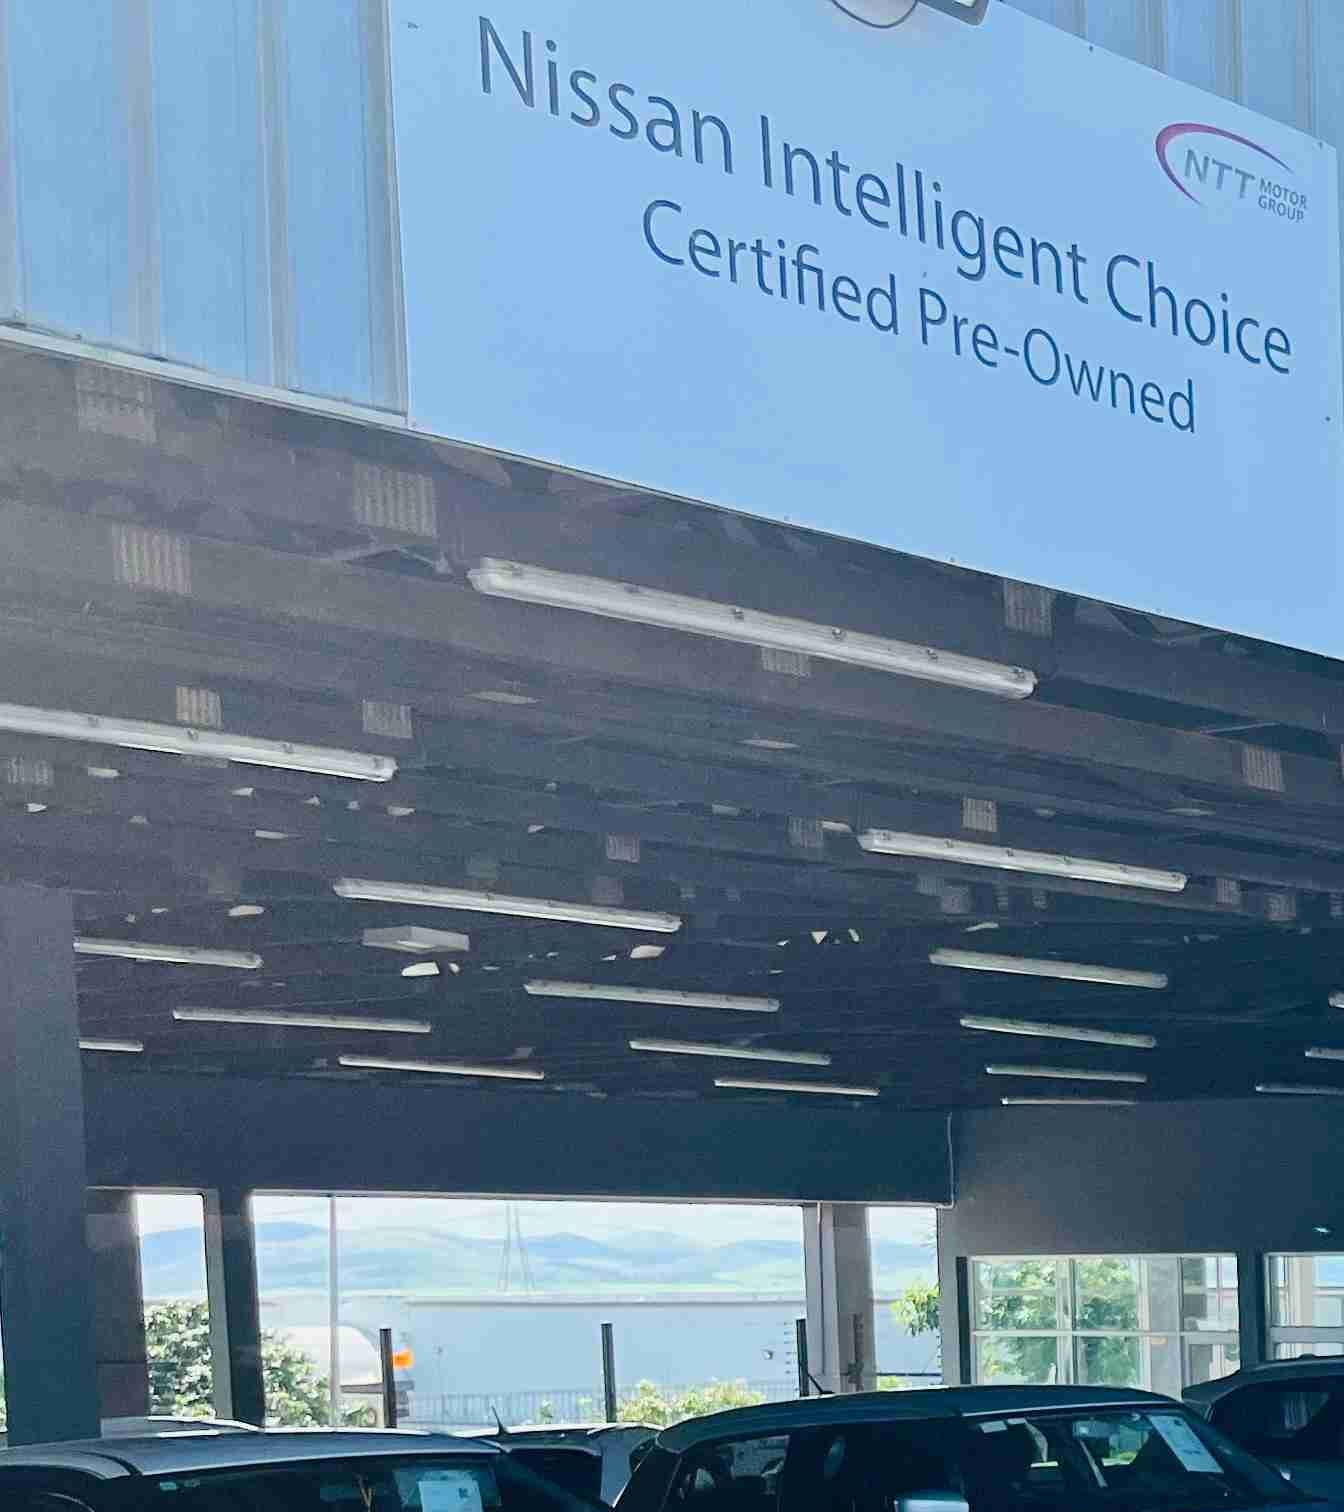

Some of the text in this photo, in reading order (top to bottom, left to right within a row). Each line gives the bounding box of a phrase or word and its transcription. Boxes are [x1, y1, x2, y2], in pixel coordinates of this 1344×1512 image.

[478, 16, 1293, 374] Nissan Intelligent Choice
[1184, 149, 1256, 199] NTT
[1258, 177, 1307, 209] MOTOR
[1257, 195, 1305, 223] GROUP
[641, 199, 1196, 433] Certified Pre-Owned
